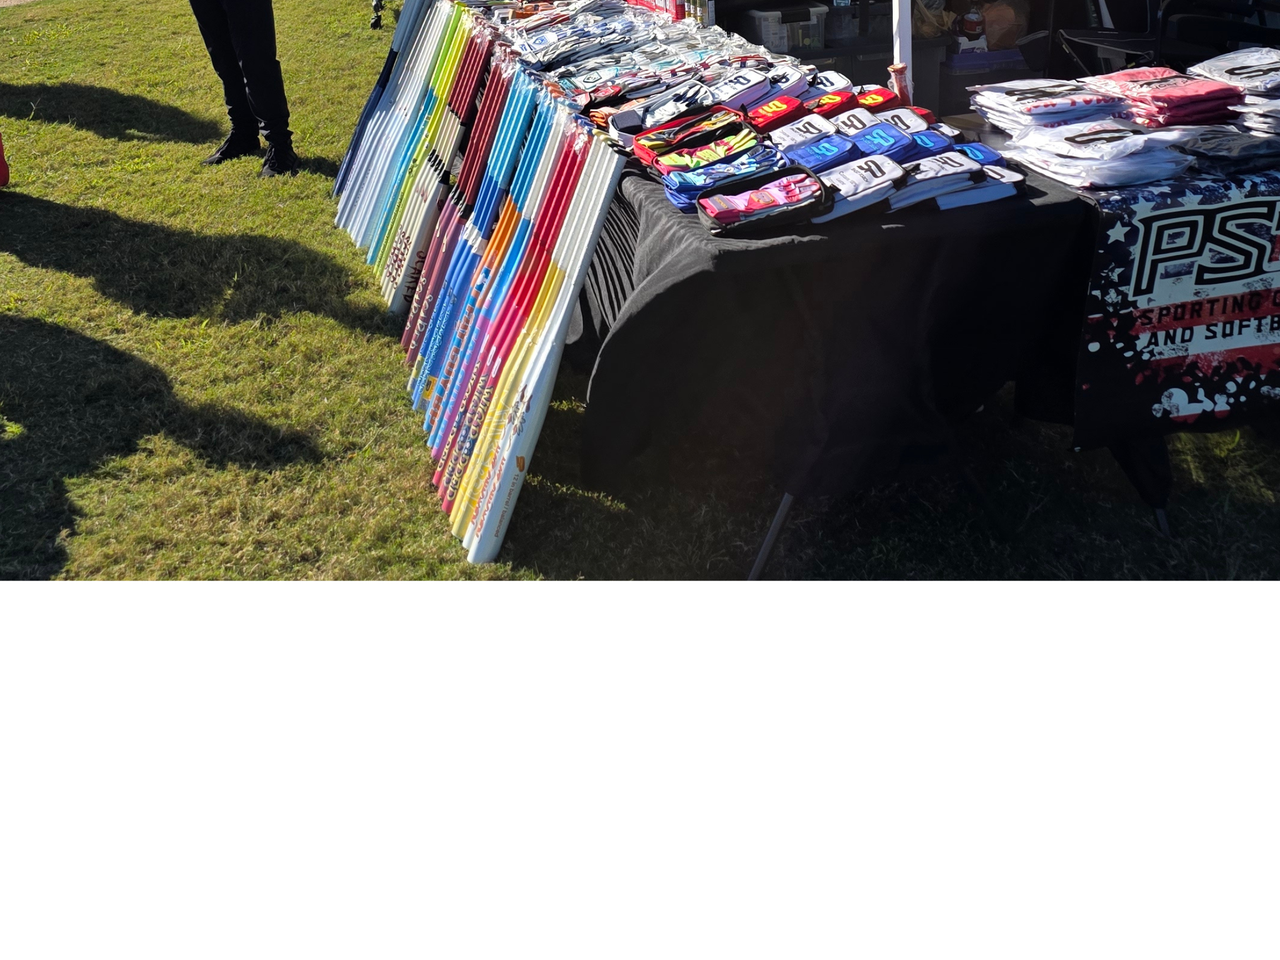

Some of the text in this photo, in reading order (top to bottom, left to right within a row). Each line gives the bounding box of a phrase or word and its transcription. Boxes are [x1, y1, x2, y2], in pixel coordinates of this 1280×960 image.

[1132, 201, 1277, 298] PS
[1140, 291, 1262, 327] SPORTING
[1147, 326, 1194, 348] AND
[505, 487, 514, 506] barrel
[494, 508, 507, 537] balanced
